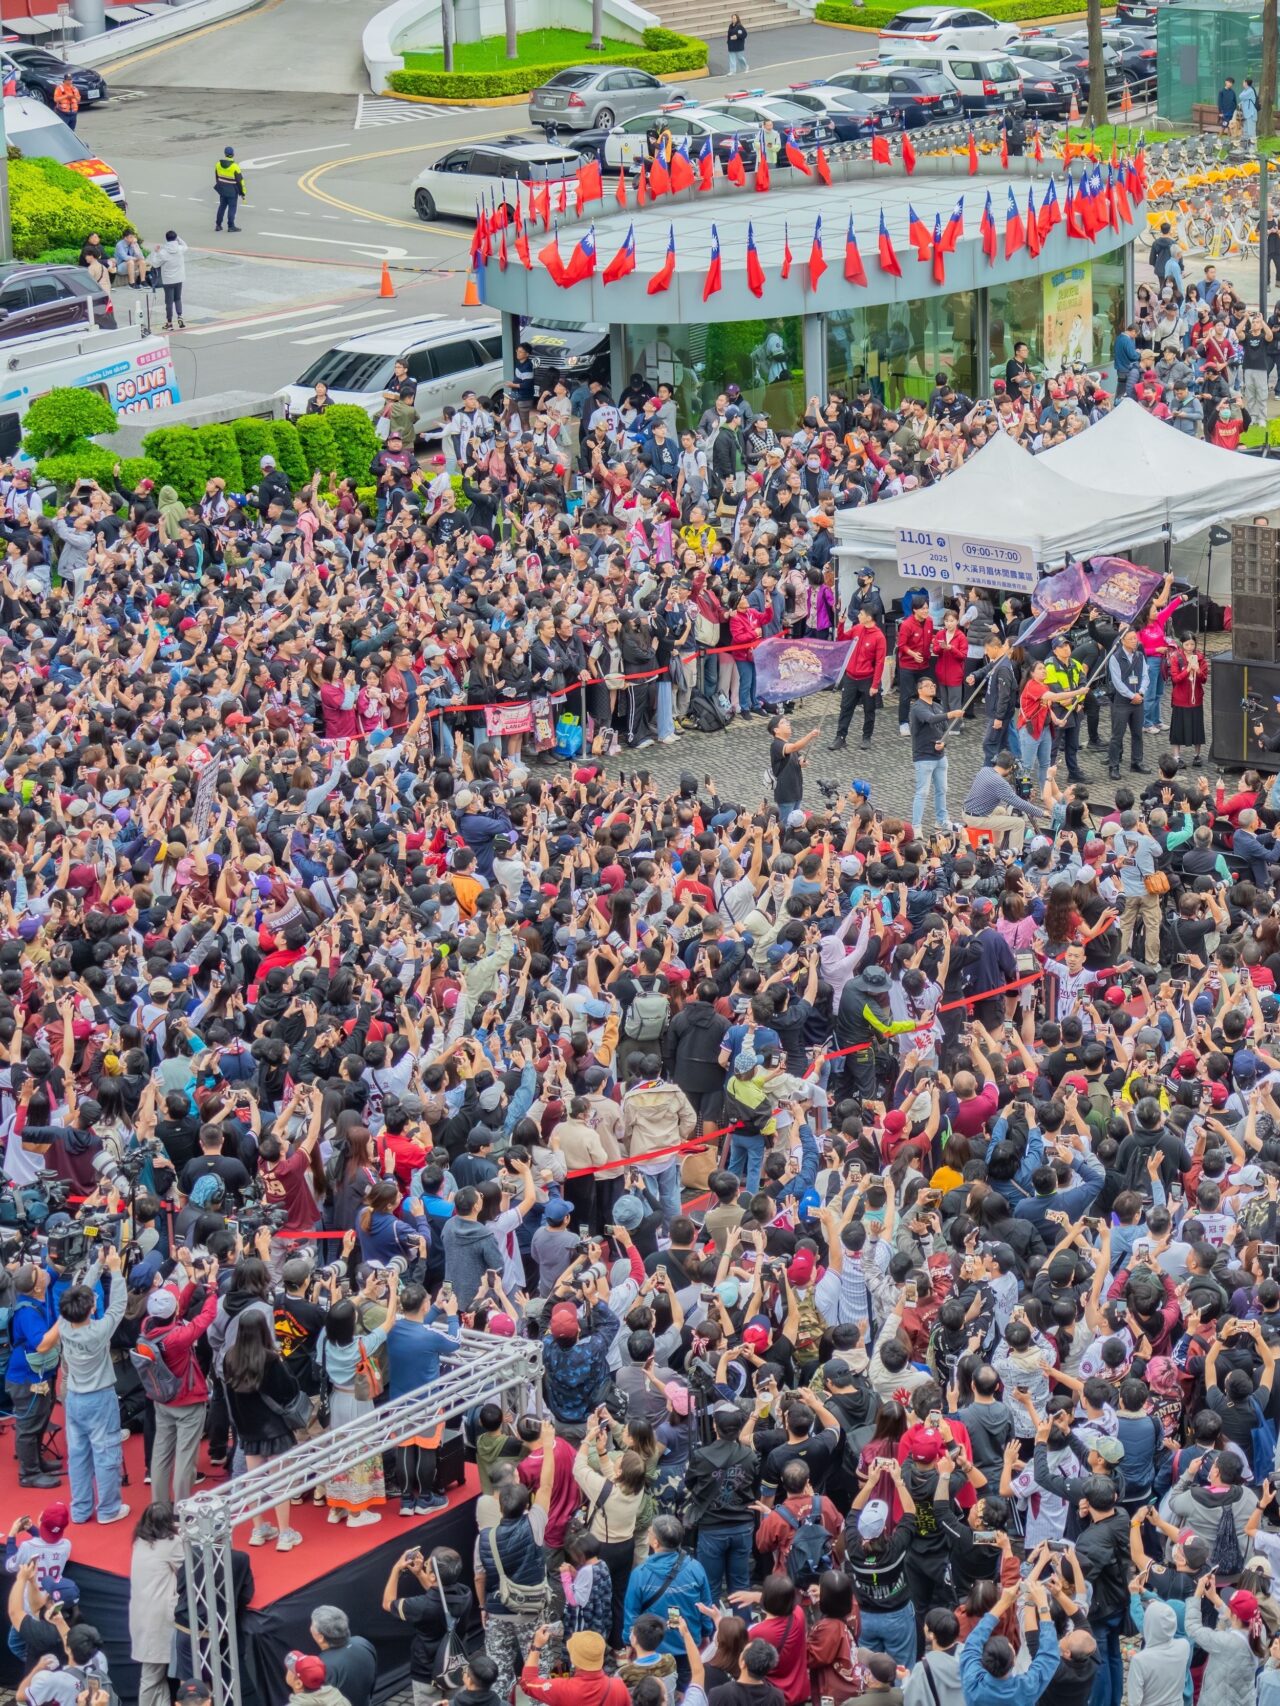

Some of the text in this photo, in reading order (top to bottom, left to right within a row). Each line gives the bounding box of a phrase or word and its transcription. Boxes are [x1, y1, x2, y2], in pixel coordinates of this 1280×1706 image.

[117, 366, 166, 402] 5G LIVE
[900, 530, 933, 546] 11.01
[929, 553, 948, 562] 2025
[966, 545, 1018, 561] 09:00-17:00
[903, 563, 936, 578] 11.09
